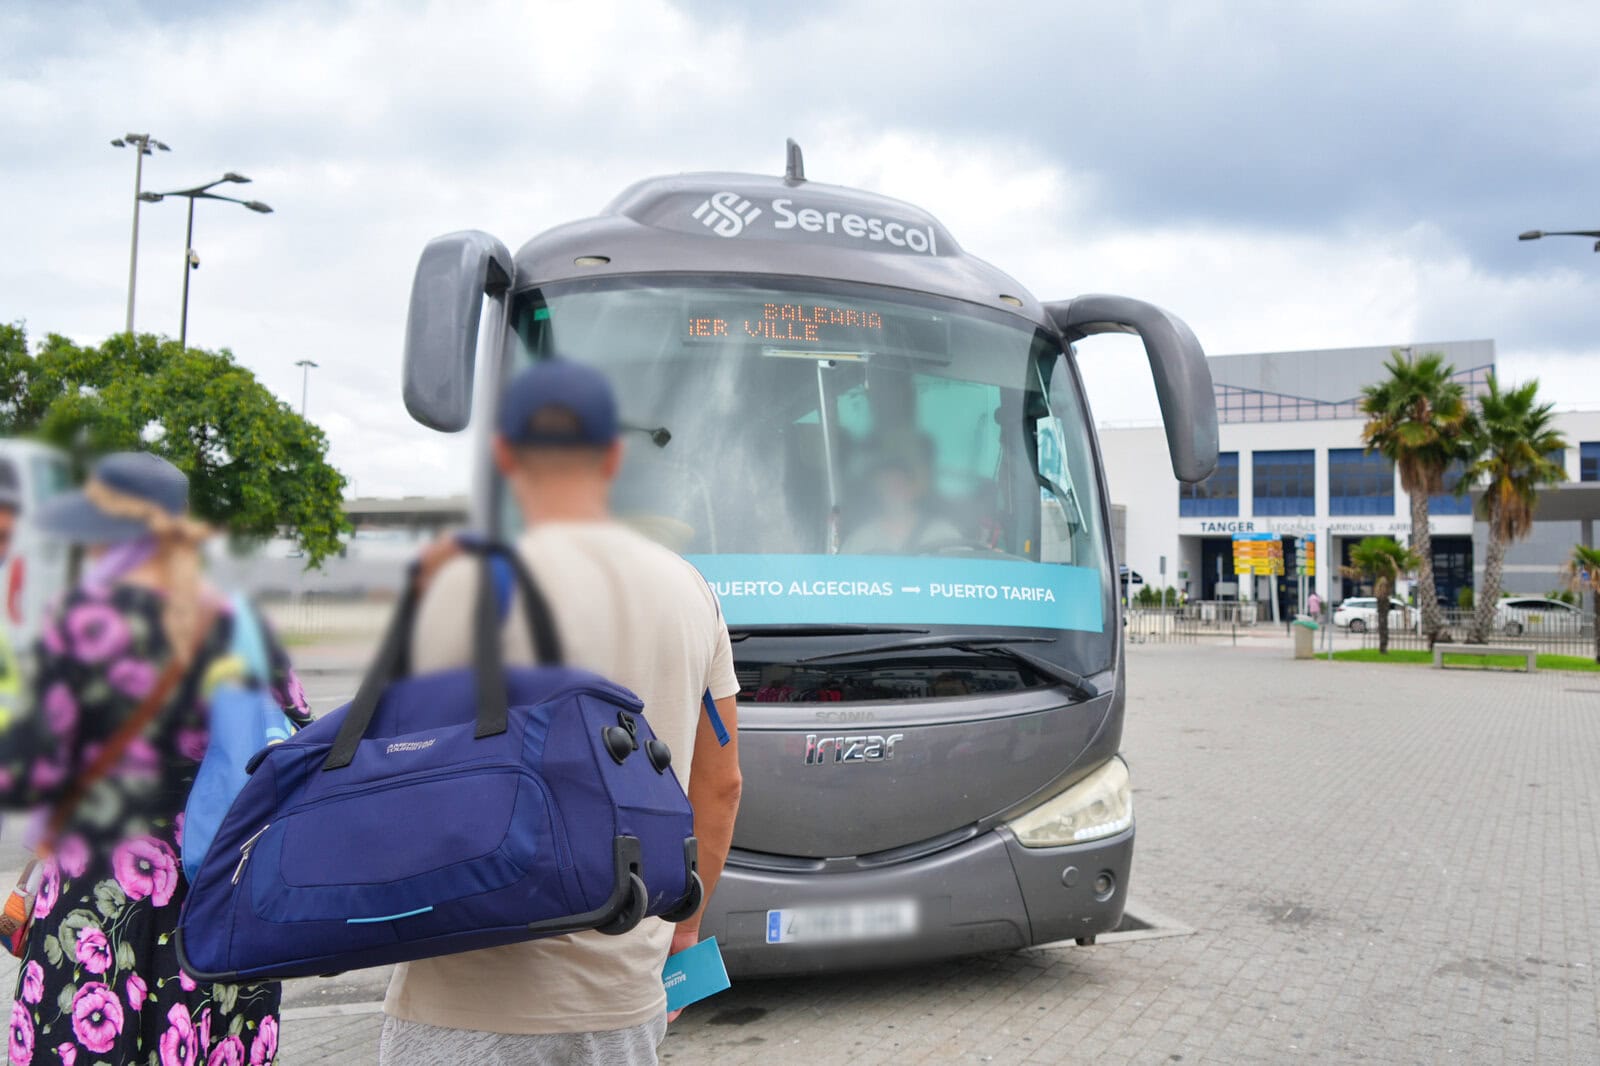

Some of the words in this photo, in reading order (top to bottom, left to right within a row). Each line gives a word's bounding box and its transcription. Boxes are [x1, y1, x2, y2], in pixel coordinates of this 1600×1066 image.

[772, 198, 937, 256] Serescol
[764, 303, 881, 328] BALEARIA
[689, 319, 729, 336] ER
[744, 320, 819, 341] VILLE
[1200, 521, 1255, 532] TANGER
[788, 580, 894, 597] ALGECIRAS
[929, 583, 998, 599] PUERTO
[1000, 585, 1056, 603] TARIFA
[815, 711, 876, 723] SCANIA
